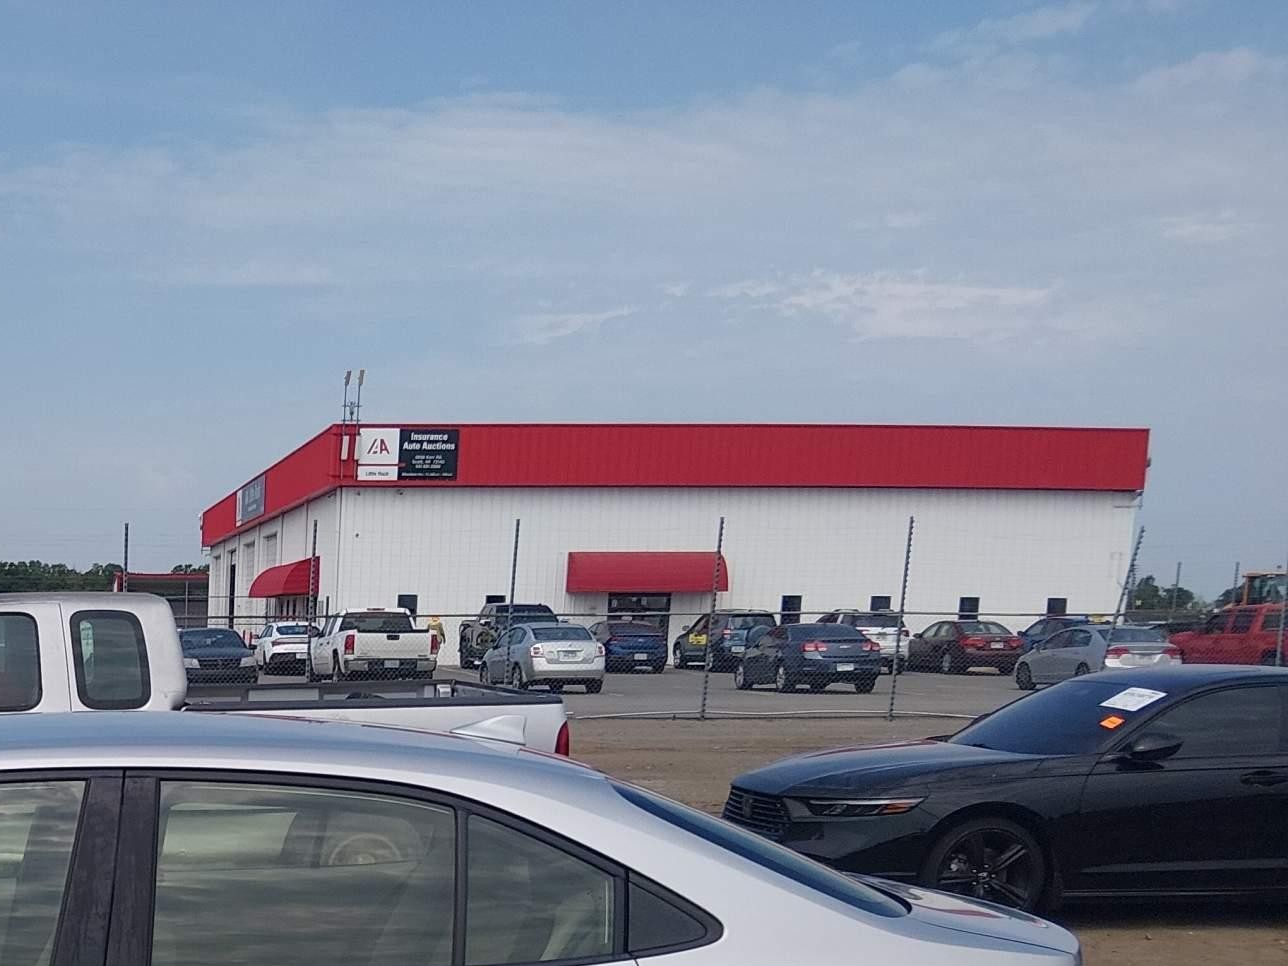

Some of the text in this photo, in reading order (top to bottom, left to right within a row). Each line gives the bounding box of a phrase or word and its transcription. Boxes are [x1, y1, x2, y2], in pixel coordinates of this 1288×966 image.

[411, 432, 448, 441] Insurance
[403, 442, 455, 450] Auto Auctions
